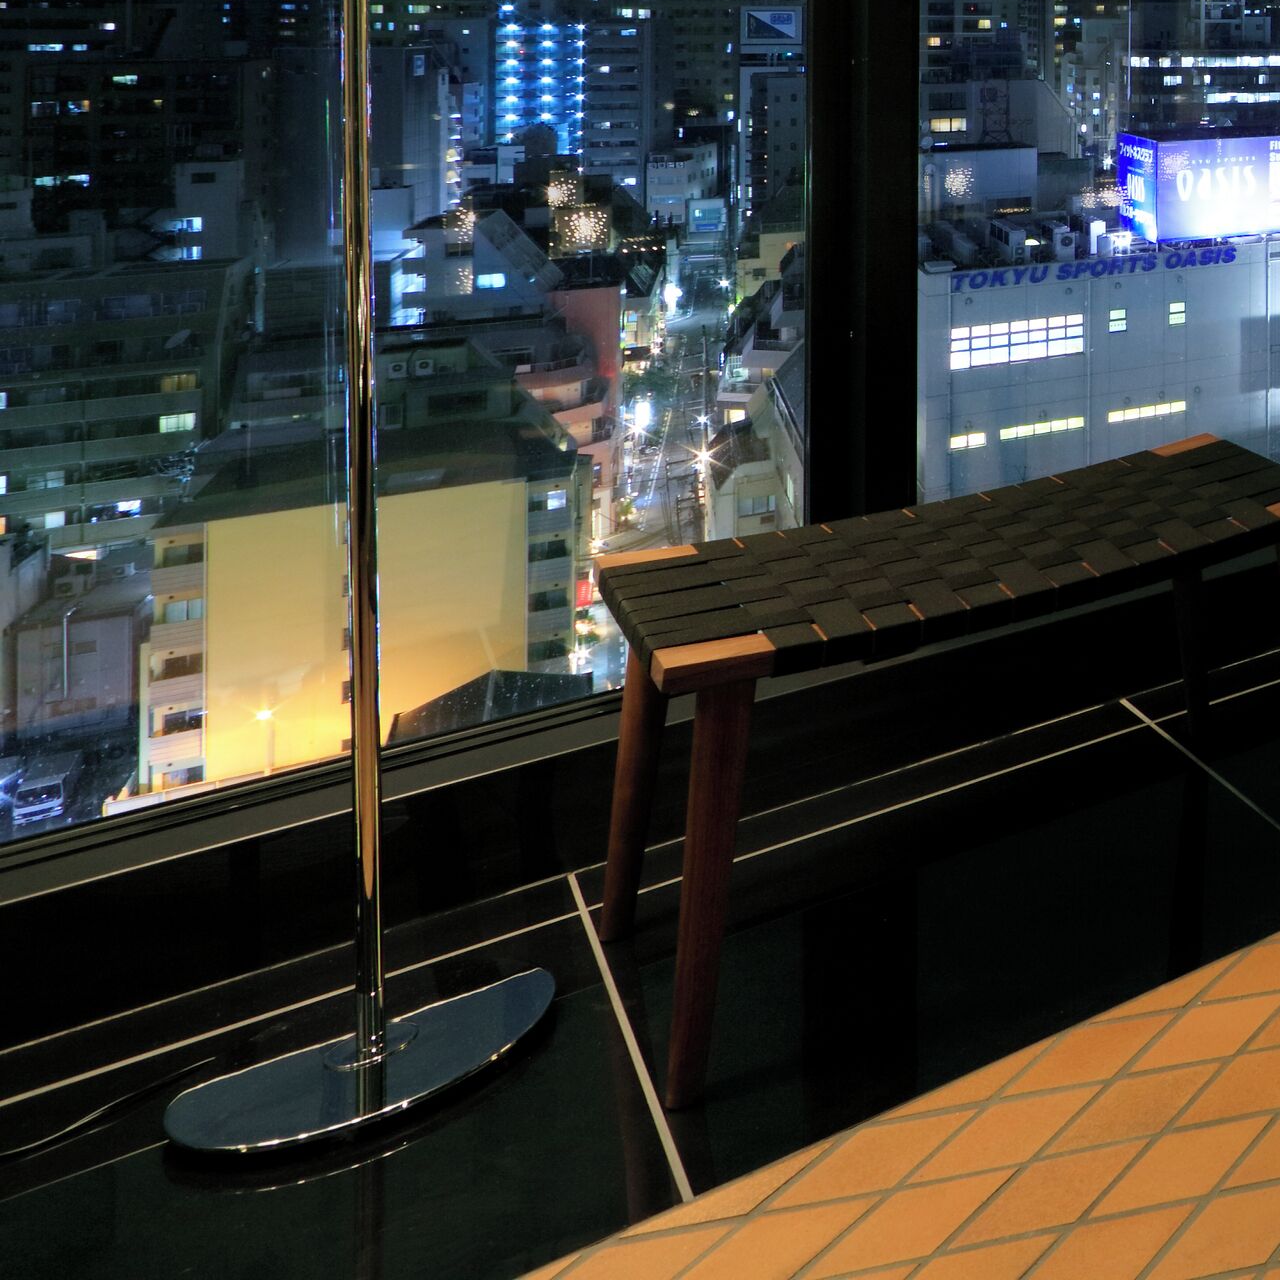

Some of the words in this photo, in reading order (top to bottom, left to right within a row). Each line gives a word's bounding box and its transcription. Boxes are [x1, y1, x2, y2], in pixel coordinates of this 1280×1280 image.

[952, 266, 1048, 292] TOKYU
[1056, 254, 1158, 281] SPORTS
[1165, 247, 1238, 270] OASIS
